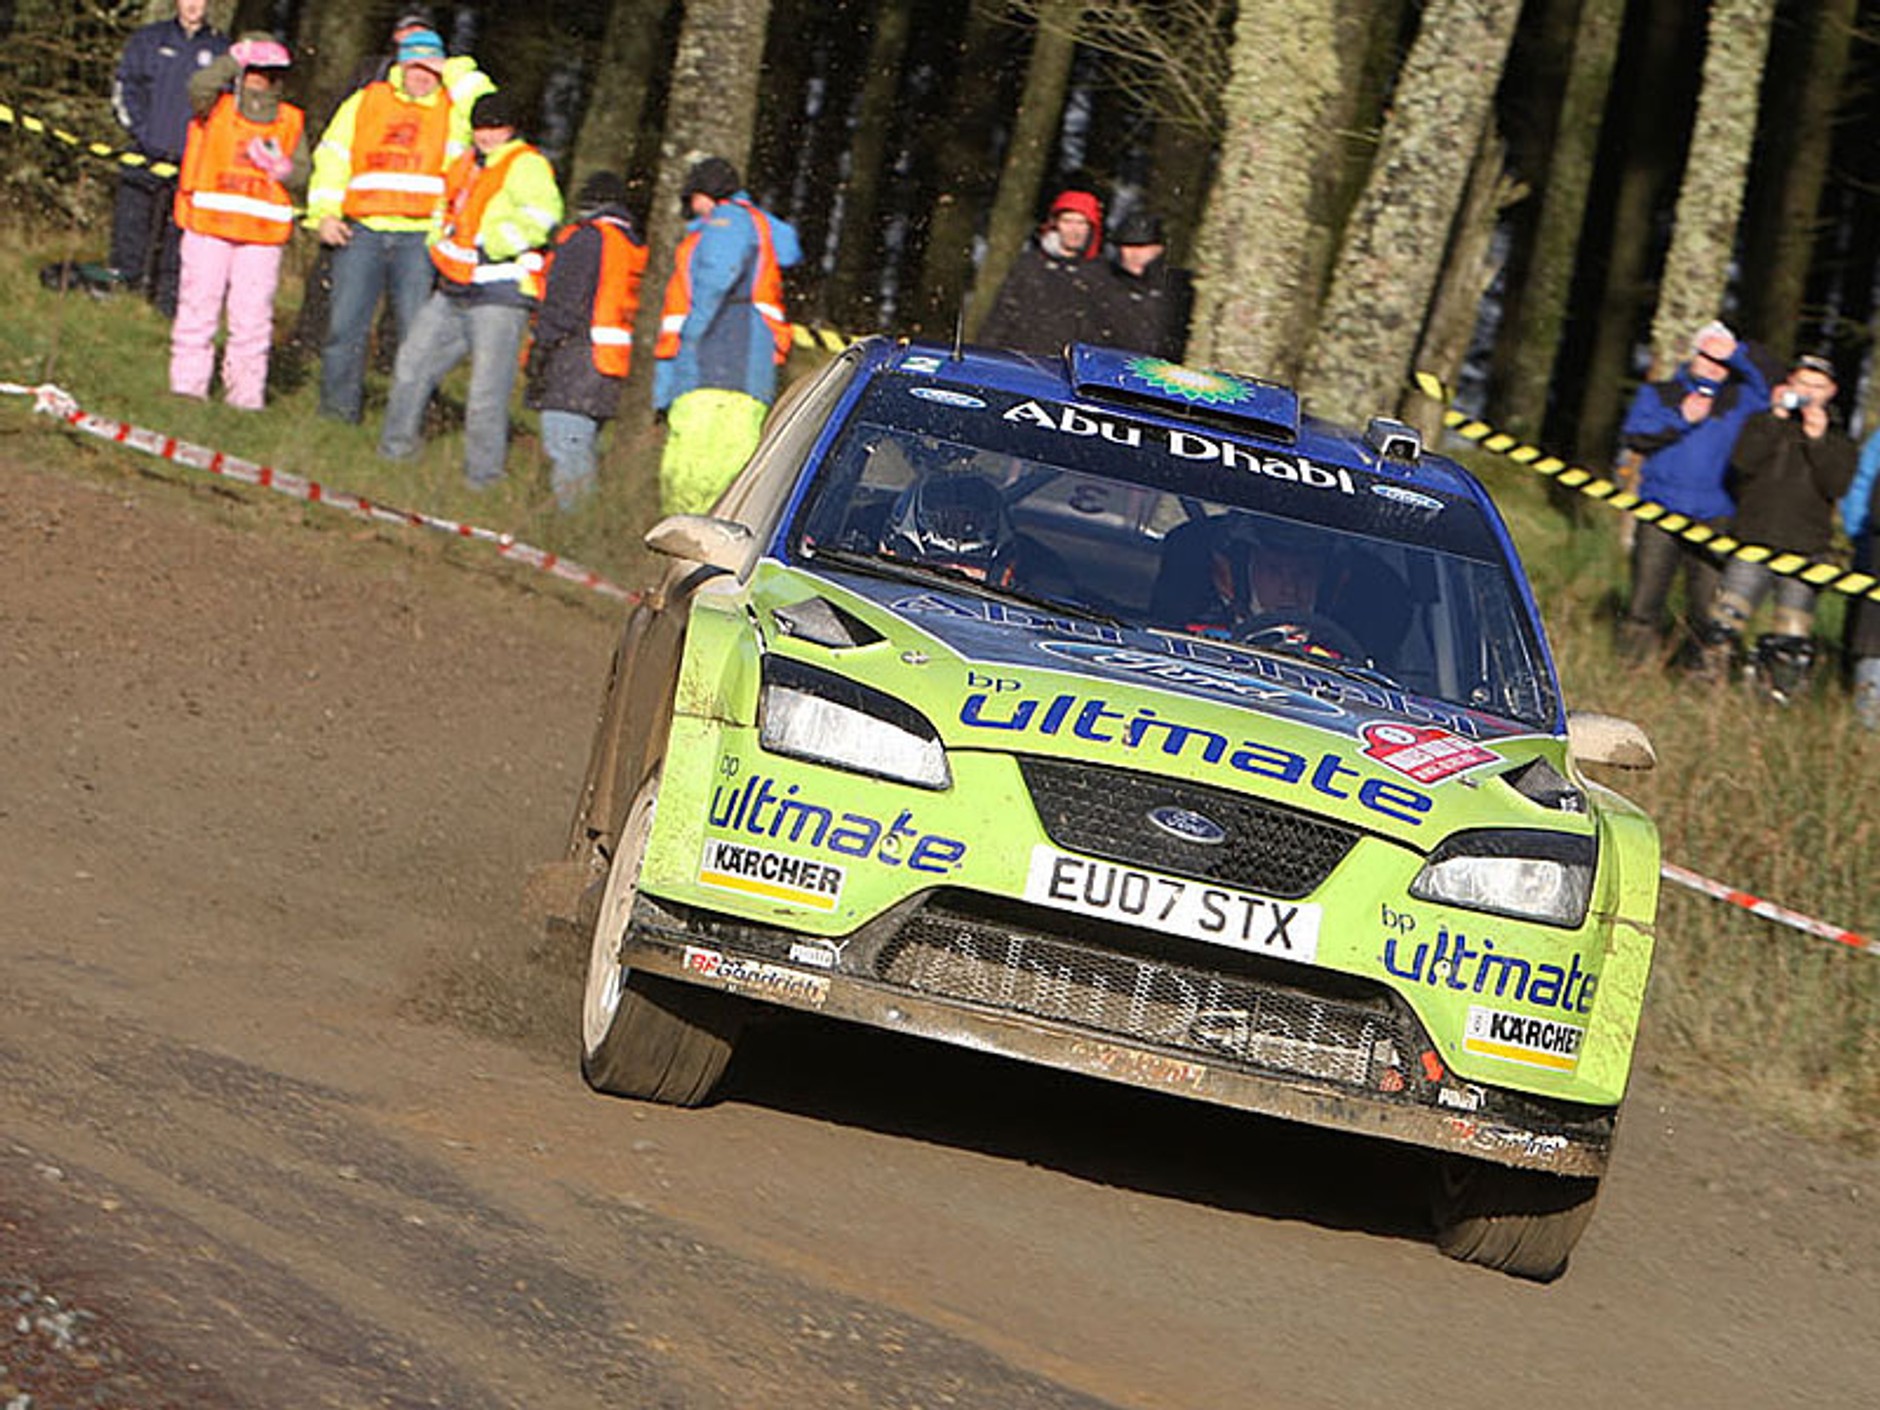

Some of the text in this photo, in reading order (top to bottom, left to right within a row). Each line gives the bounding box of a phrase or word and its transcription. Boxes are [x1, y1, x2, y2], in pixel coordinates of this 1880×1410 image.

[1002, 399, 1356, 496] Abu Dhabi
[890, 594, 1122, 644] Abu
[968, 671, 1022, 693] bp
[959, 694, 1434, 826] ultimate
[708, 774, 967, 874] ultimate
[713, 842, 842, 895] KÄRCHER
[1047, 857, 1299, 950] EU07 STX
[1381, 902, 1416, 934] bp
